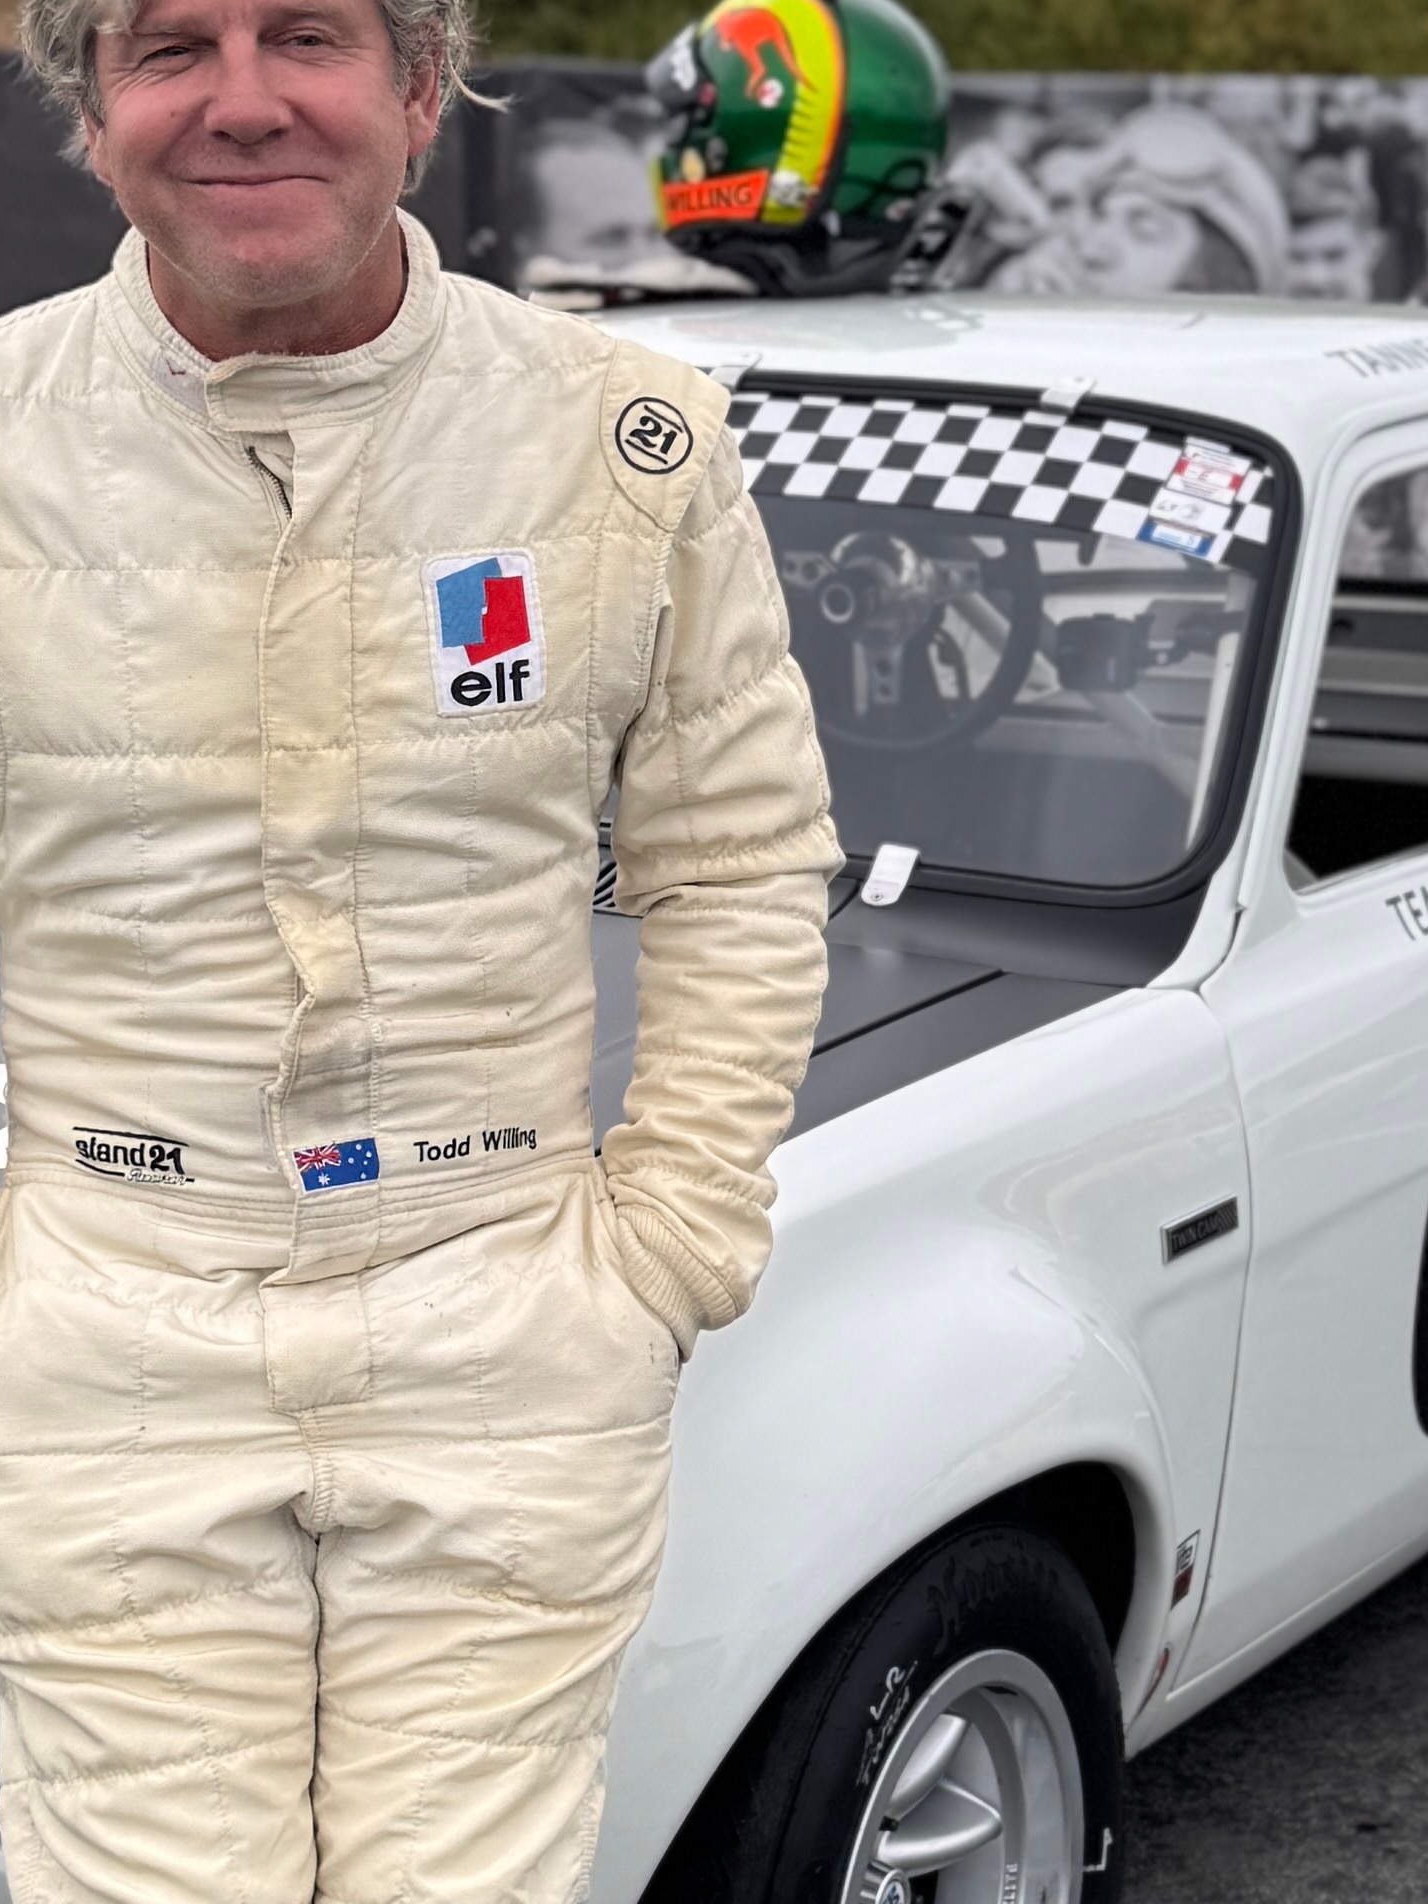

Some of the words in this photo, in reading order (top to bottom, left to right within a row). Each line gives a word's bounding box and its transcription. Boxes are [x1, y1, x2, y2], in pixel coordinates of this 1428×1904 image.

[628, 415, 678, 455] 21
[450, 659, 531, 707] elf
[412, 1134, 472, 1163] Todd
[481, 1126, 538, 1151] Willing
